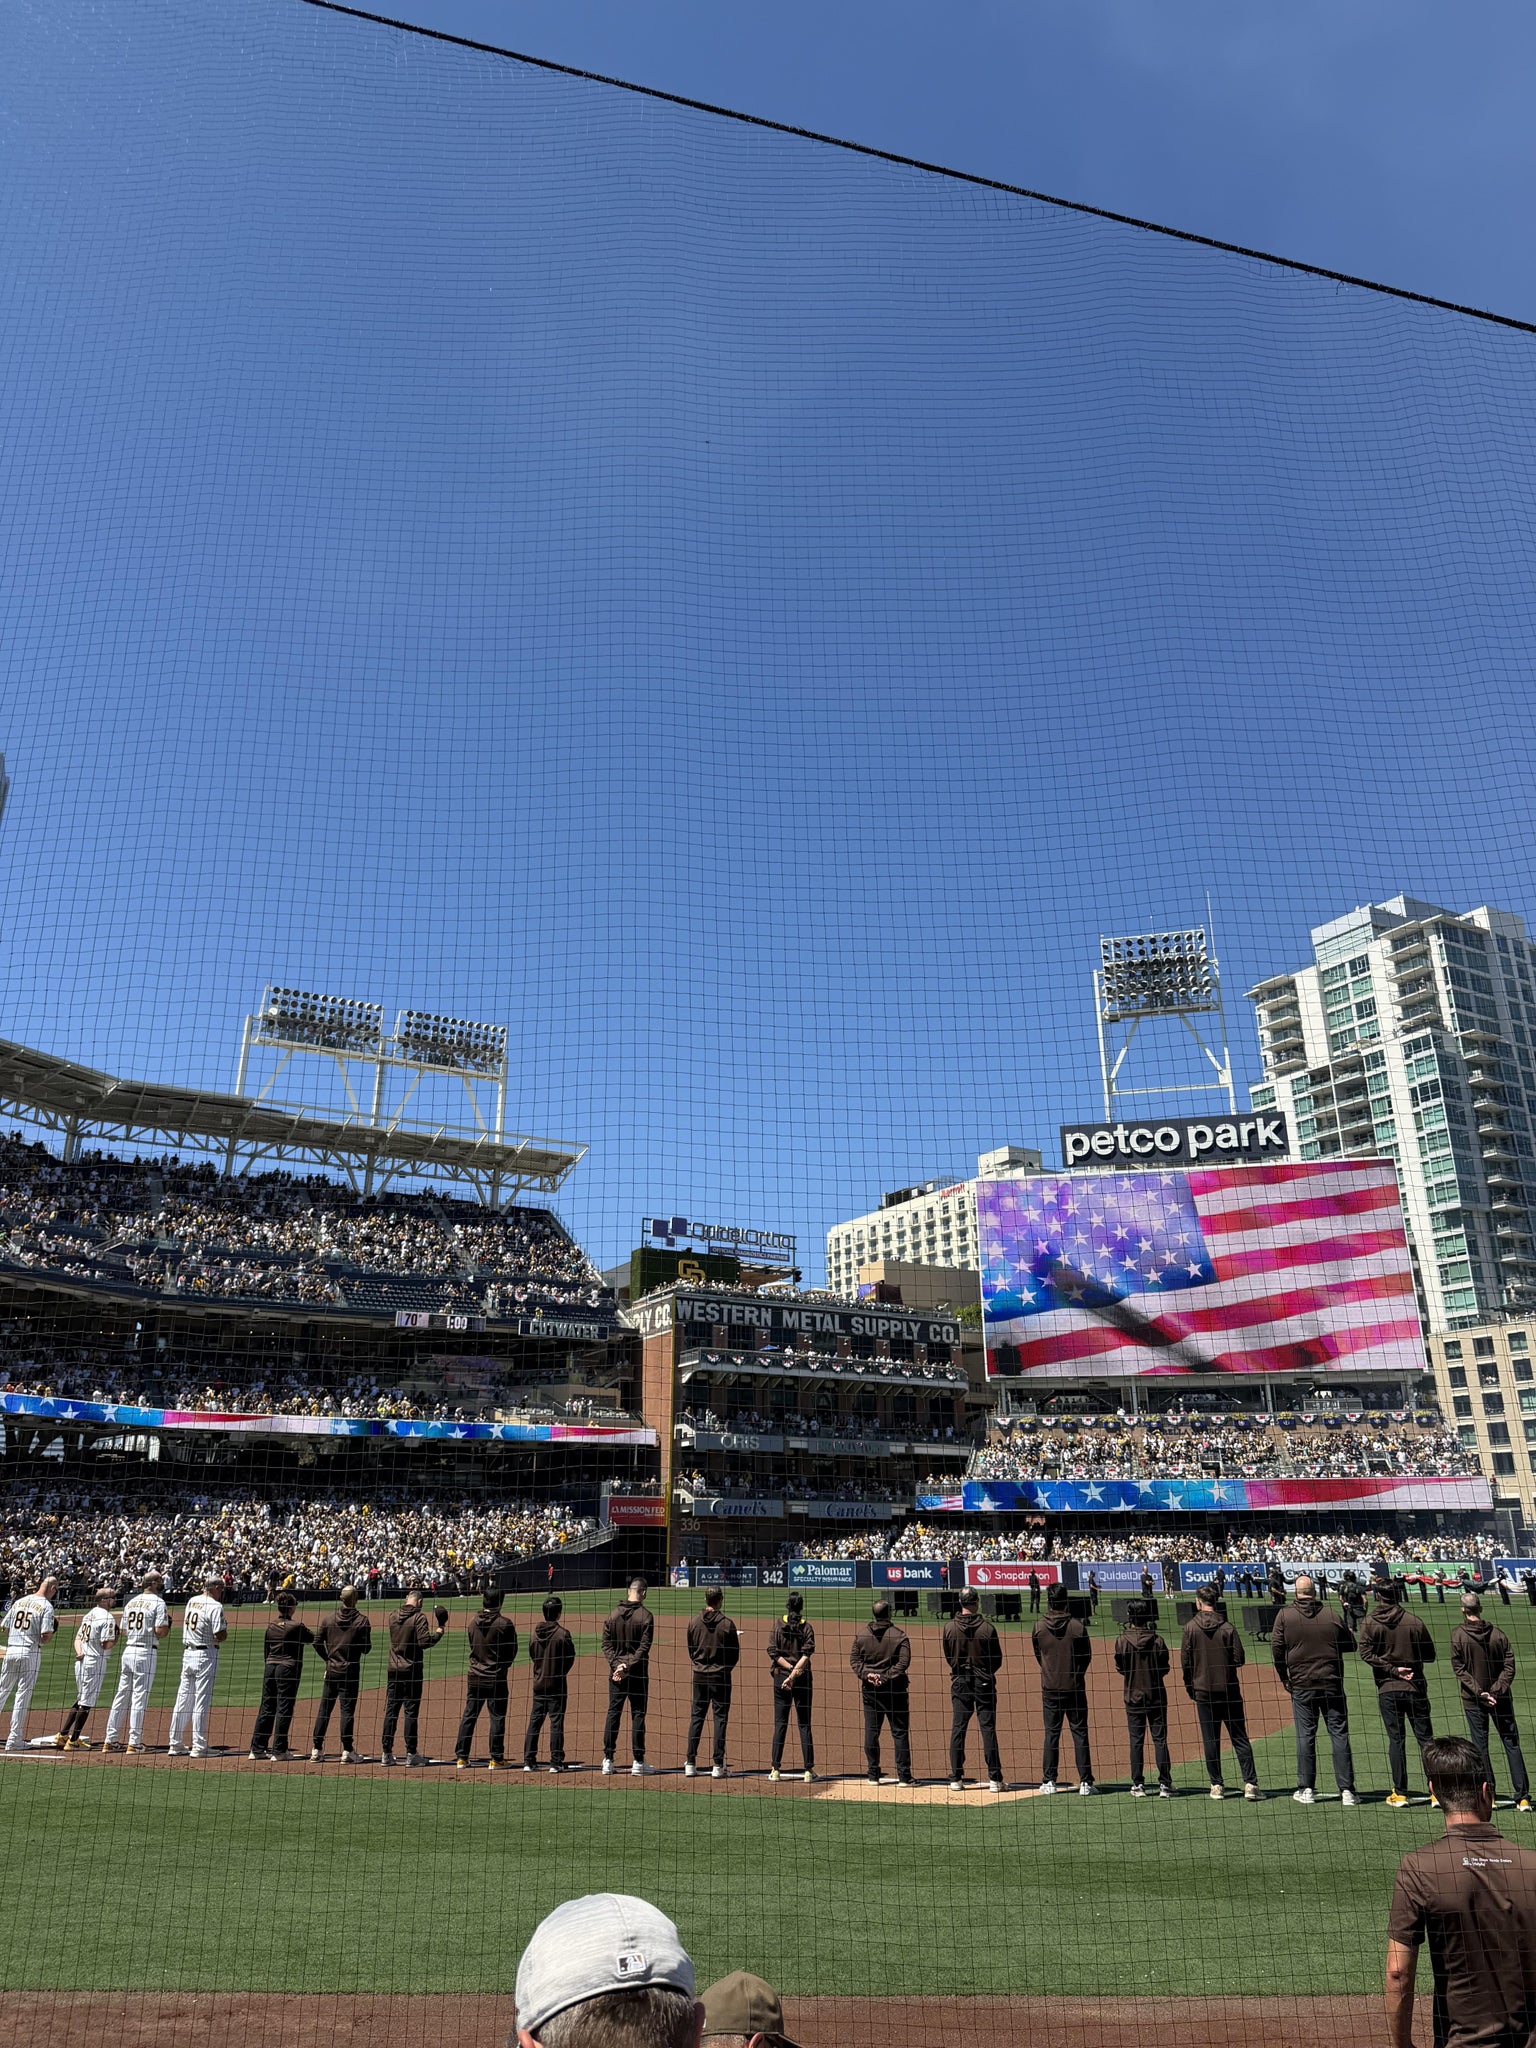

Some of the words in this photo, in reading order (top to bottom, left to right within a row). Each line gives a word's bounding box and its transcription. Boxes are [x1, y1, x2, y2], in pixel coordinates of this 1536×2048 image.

[1065, 1124, 1180, 1165] petco
[1187, 1117, 1284, 1158] park
[691, 1222, 790, 1249] QuidelOrtho
[446, 1316, 468, 1329] 1:00
[676, 1299, 772, 1328] WESTERN
[782, 1309, 846, 1334] METAL
[851, 1316, 921, 1341] SUPPLY
[929, 1324, 959, 1344] CO.
[529, 1321, 600, 1339] CUTWATER
[721, 1434, 760, 1450] ORIS
[620, 1506, 650, 1514] MISSION
[651, 1506, 665, 1514] FED
[680, 1518, 700, 1531] 336
[762, 1570, 784, 1584] 342
[807, 1564, 852, 1576] Palomar
[888, 1569, 902, 1578] us
[903, 1567, 932, 1579] bank
[994, 1570, 1050, 1581] Snapdron
[1099, 1571, 1159, 1582] QuidelOro
[14, 1610, 33, 1630] 85
[128, 1611, 144, 1630] 28
[185, 1611, 199, 1631] 49
